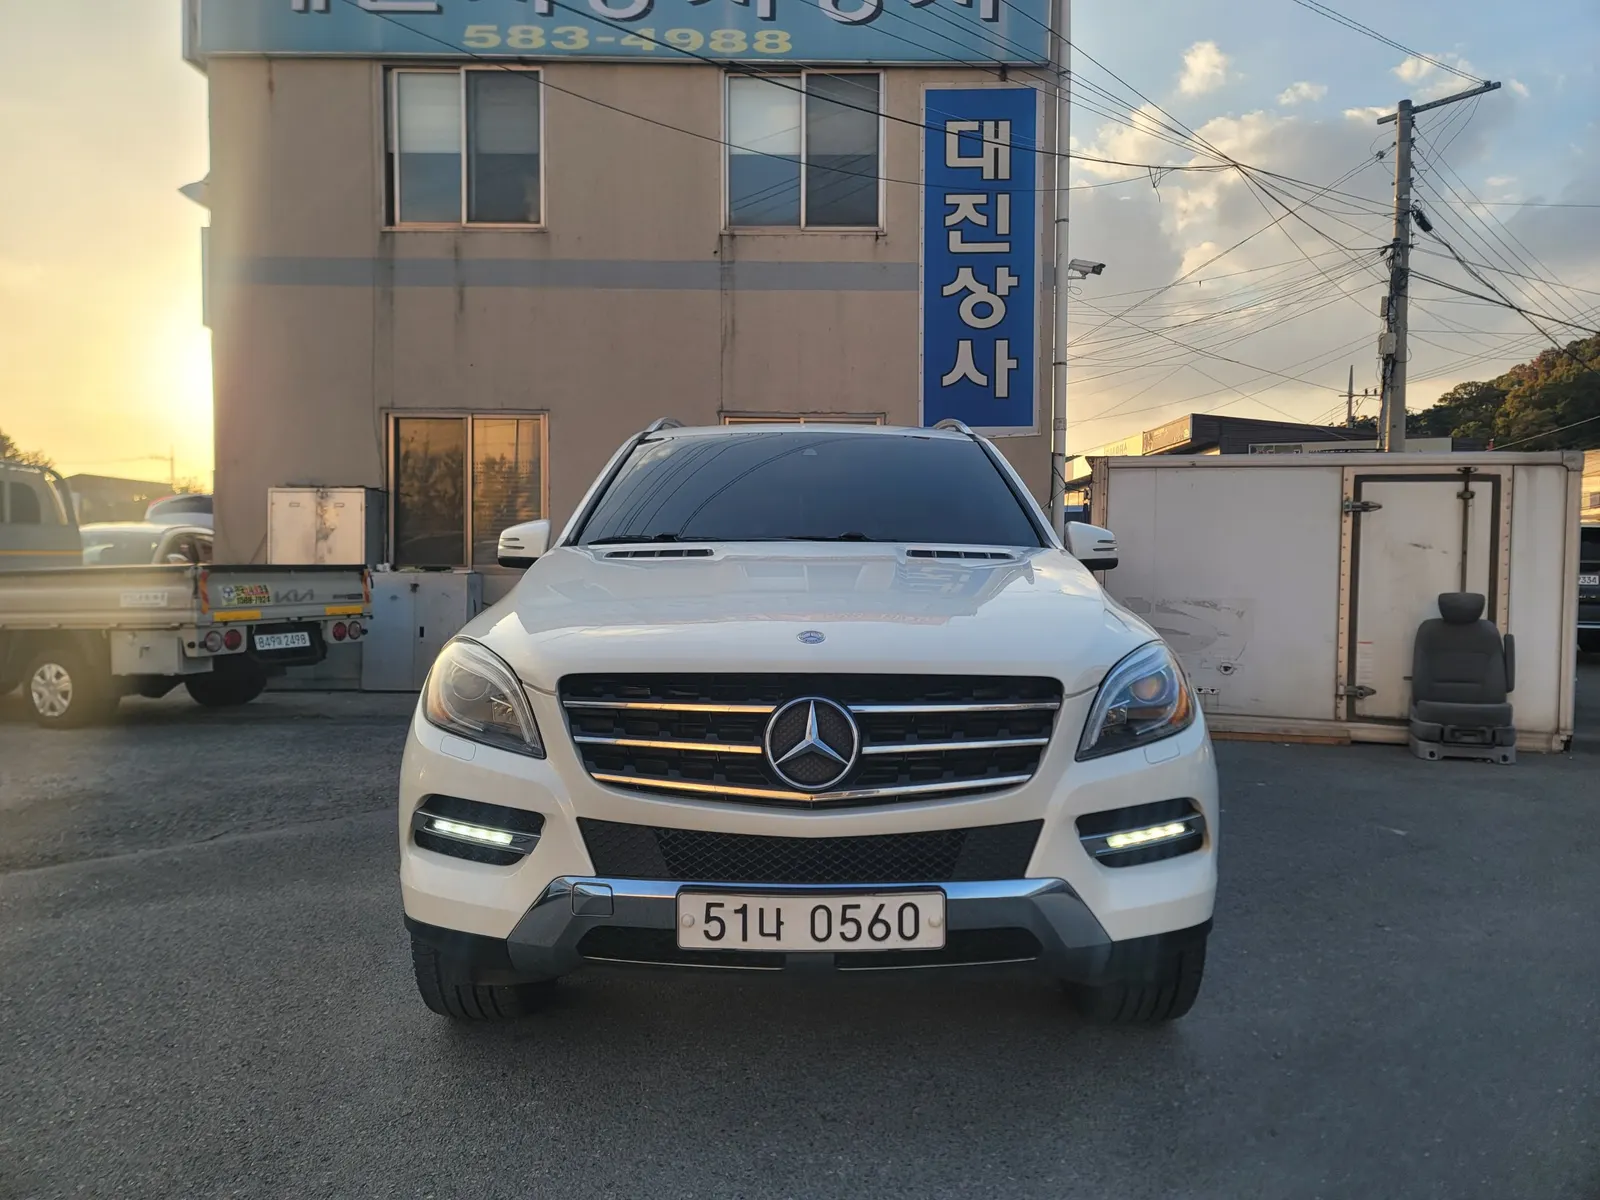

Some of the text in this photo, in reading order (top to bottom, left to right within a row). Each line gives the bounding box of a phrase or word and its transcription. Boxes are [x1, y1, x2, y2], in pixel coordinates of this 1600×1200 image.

[463, 23, 793, 54] 583-4988
[942, 119, 1020, 399] 대진상사
[703, 902, 919, 942] 51나 0560
